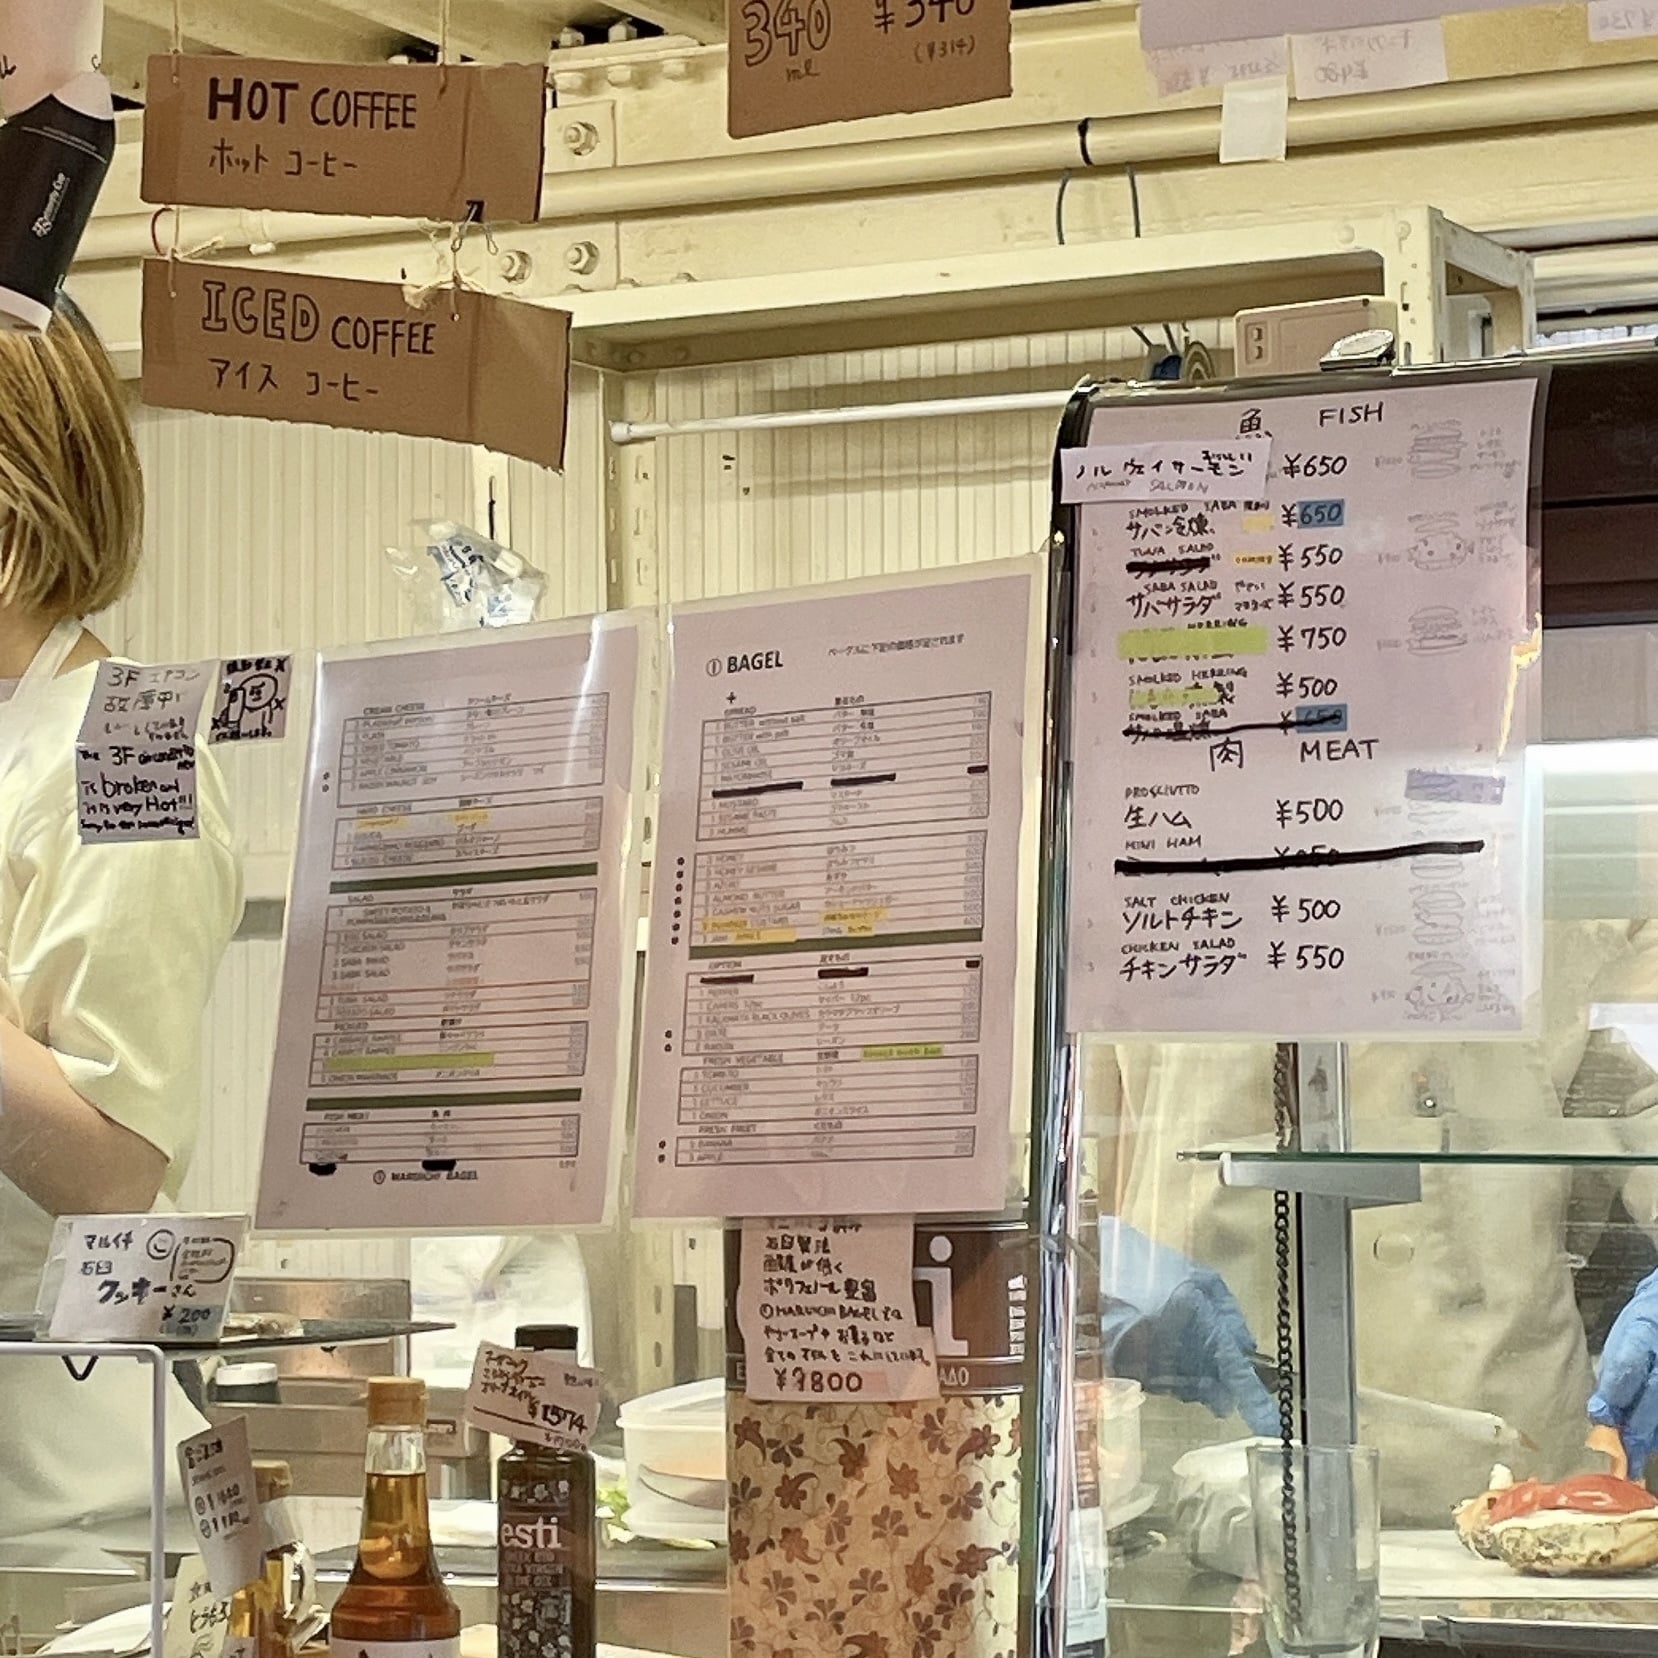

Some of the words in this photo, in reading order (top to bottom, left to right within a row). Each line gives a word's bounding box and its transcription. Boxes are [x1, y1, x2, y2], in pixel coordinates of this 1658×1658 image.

[742, 0, 831, 67] 340
[207, 77, 298, 122] HOT
[311, 87, 416, 129] COFFEE
[209, 138, 269, 176] ホット
[285, 149, 358, 177] コーヒー
[201, 280, 320, 343] ICED
[331, 316, 436, 357] COFFEE
[209, 358, 278, 394] アイス
[306, 372, 379, 402] コーヒー
[1238, 407, 1272, 440] 魚
[1319, 401, 1384, 427] FISH
[1283, 452, 1349, 479] ¥650
[1281, 500, 1345, 528] ¥650
[1278, 545, 1344, 571] ¥550
[1144, 582, 1175, 595] SABA
[1181, 580, 1218, 594] SALAD
[1276, 581, 1346, 609] ¥550
[1276, 624, 1347, 652] ¥750
[727, 650, 783, 674] BAGEL
[107, 667, 140, 688] 3F
[1276, 671, 1338, 699] ¥500
[109, 746, 135, 765] 3F
[1209, 738, 1244, 771] 肉
[1300, 737, 1380, 763] MEAT
[100, 772, 158, 798] broken
[1125, 783, 1200, 798] PROSCIUTTO
[1123, 804, 1193, 830] 生ハム
[1275, 798, 1344, 829] ¥500
[1166, 835, 1201, 849] HAM
[1124, 895, 1157, 908] SALT
[1169, 892, 1230, 906] CHICKEN
[1271, 896, 1341, 922] ¥500
[1123, 911, 1242, 933] ソルトチキン
[1120, 951, 1248, 981] チキンサラダ
[1121, 941, 1180, 954] CHICKEN
[1192, 937, 1236, 951] SALAD
[1267, 941, 1345, 970] ¥550
[84, 1230, 134, 1250] マルイチ
[162, 1305, 211, 1324] ¥200
[501, 1515, 562, 1549] esti
